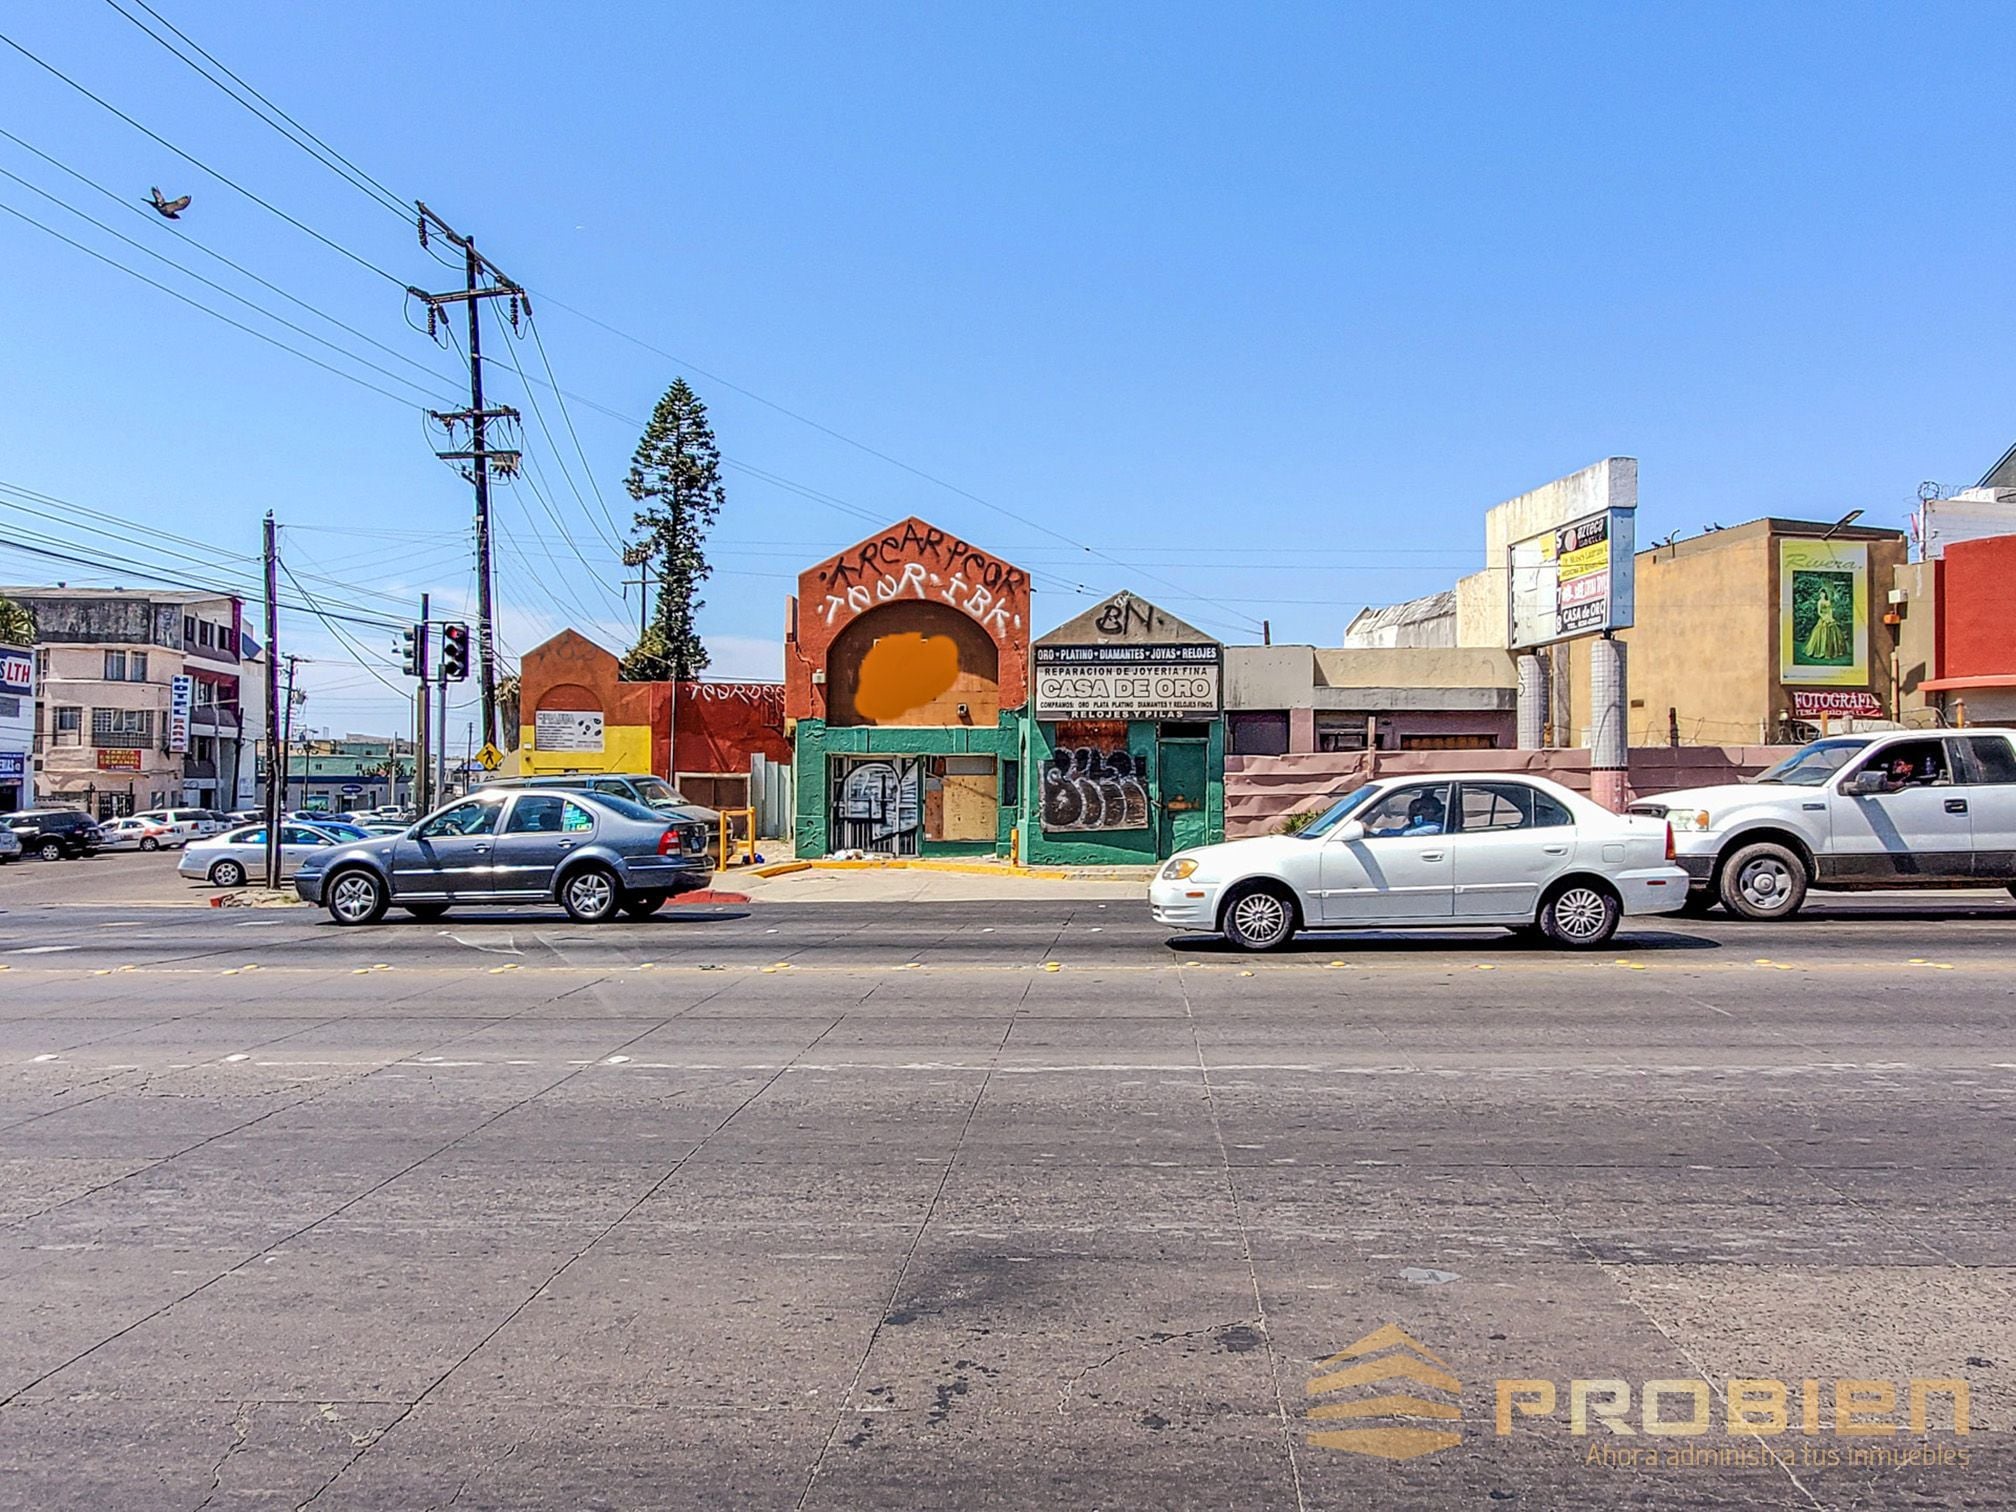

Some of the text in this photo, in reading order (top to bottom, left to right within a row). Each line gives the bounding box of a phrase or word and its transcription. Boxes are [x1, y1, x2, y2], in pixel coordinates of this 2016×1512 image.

[1563, 606, 1582, 625] CASA
[1037, 647, 1217, 660] ORO PLATINO DIAMANTES JOYAS RELOJES
[7, 661, 31, 683] LTH
[1044, 666, 1208, 676] REPARACION DE JOYERIA FINA
[173, 677, 190, 716] HOTEL
[1041, 678, 1211, 699] CASA DE ORO
[1078, 701, 1090, 709] ORO
[1093, 701, 1109, 709] PLATA
[1112, 701, 1134, 709] PLATINO
[1138, 701, 1168, 709] DIAMANTES
[1173, 701, 1196, 709] RELOJES
[1071, 711, 1184, 719] RELOJES Y PILAS
